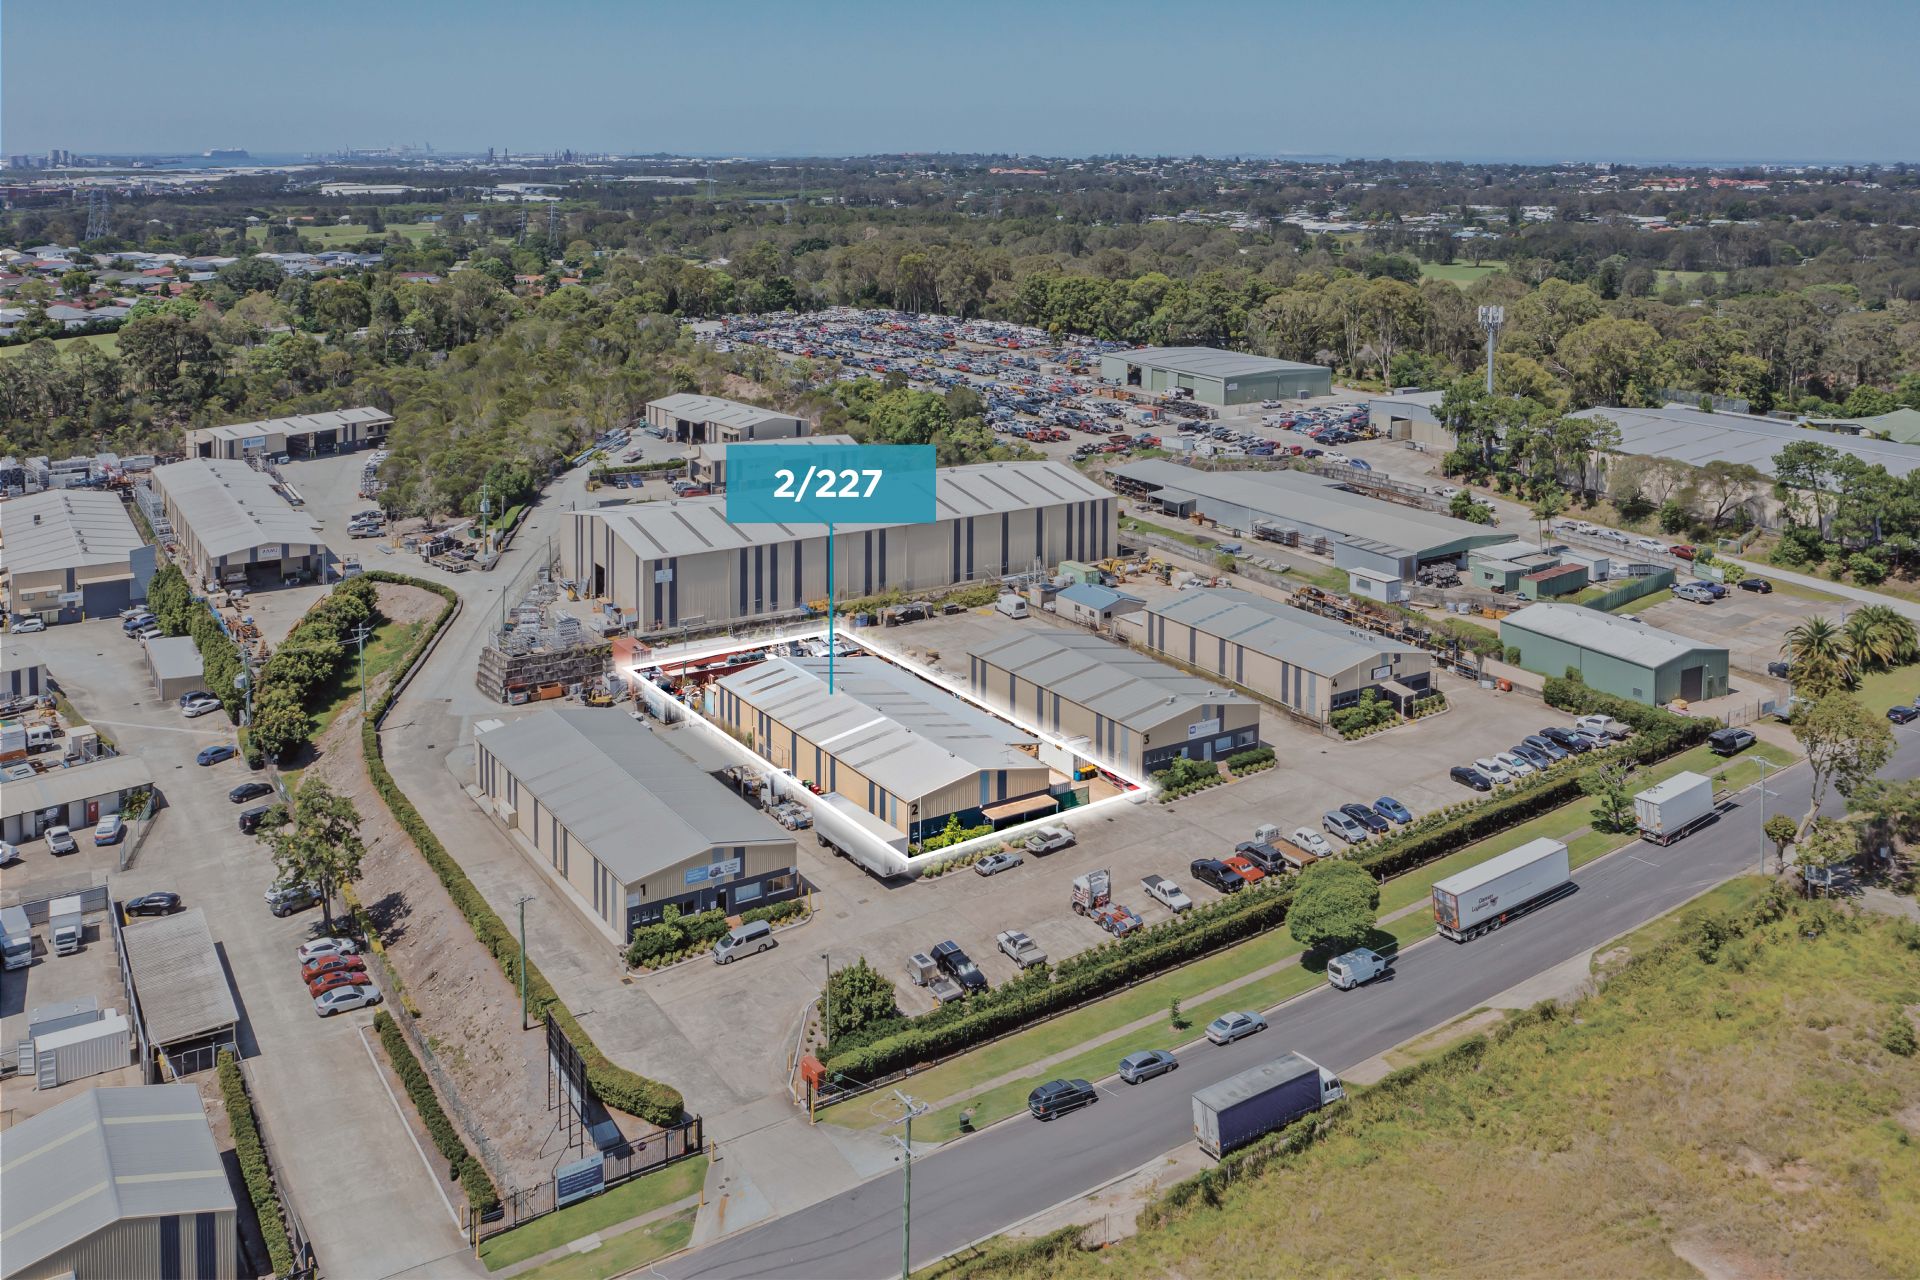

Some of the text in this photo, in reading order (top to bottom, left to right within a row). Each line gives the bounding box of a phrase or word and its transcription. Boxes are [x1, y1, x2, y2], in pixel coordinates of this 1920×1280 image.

[1332, 679, 1337, 687] 4
[1144, 734, 1150, 744] 3
[911, 804, 918, 815] 2
[640, 883, 646, 897] 1
